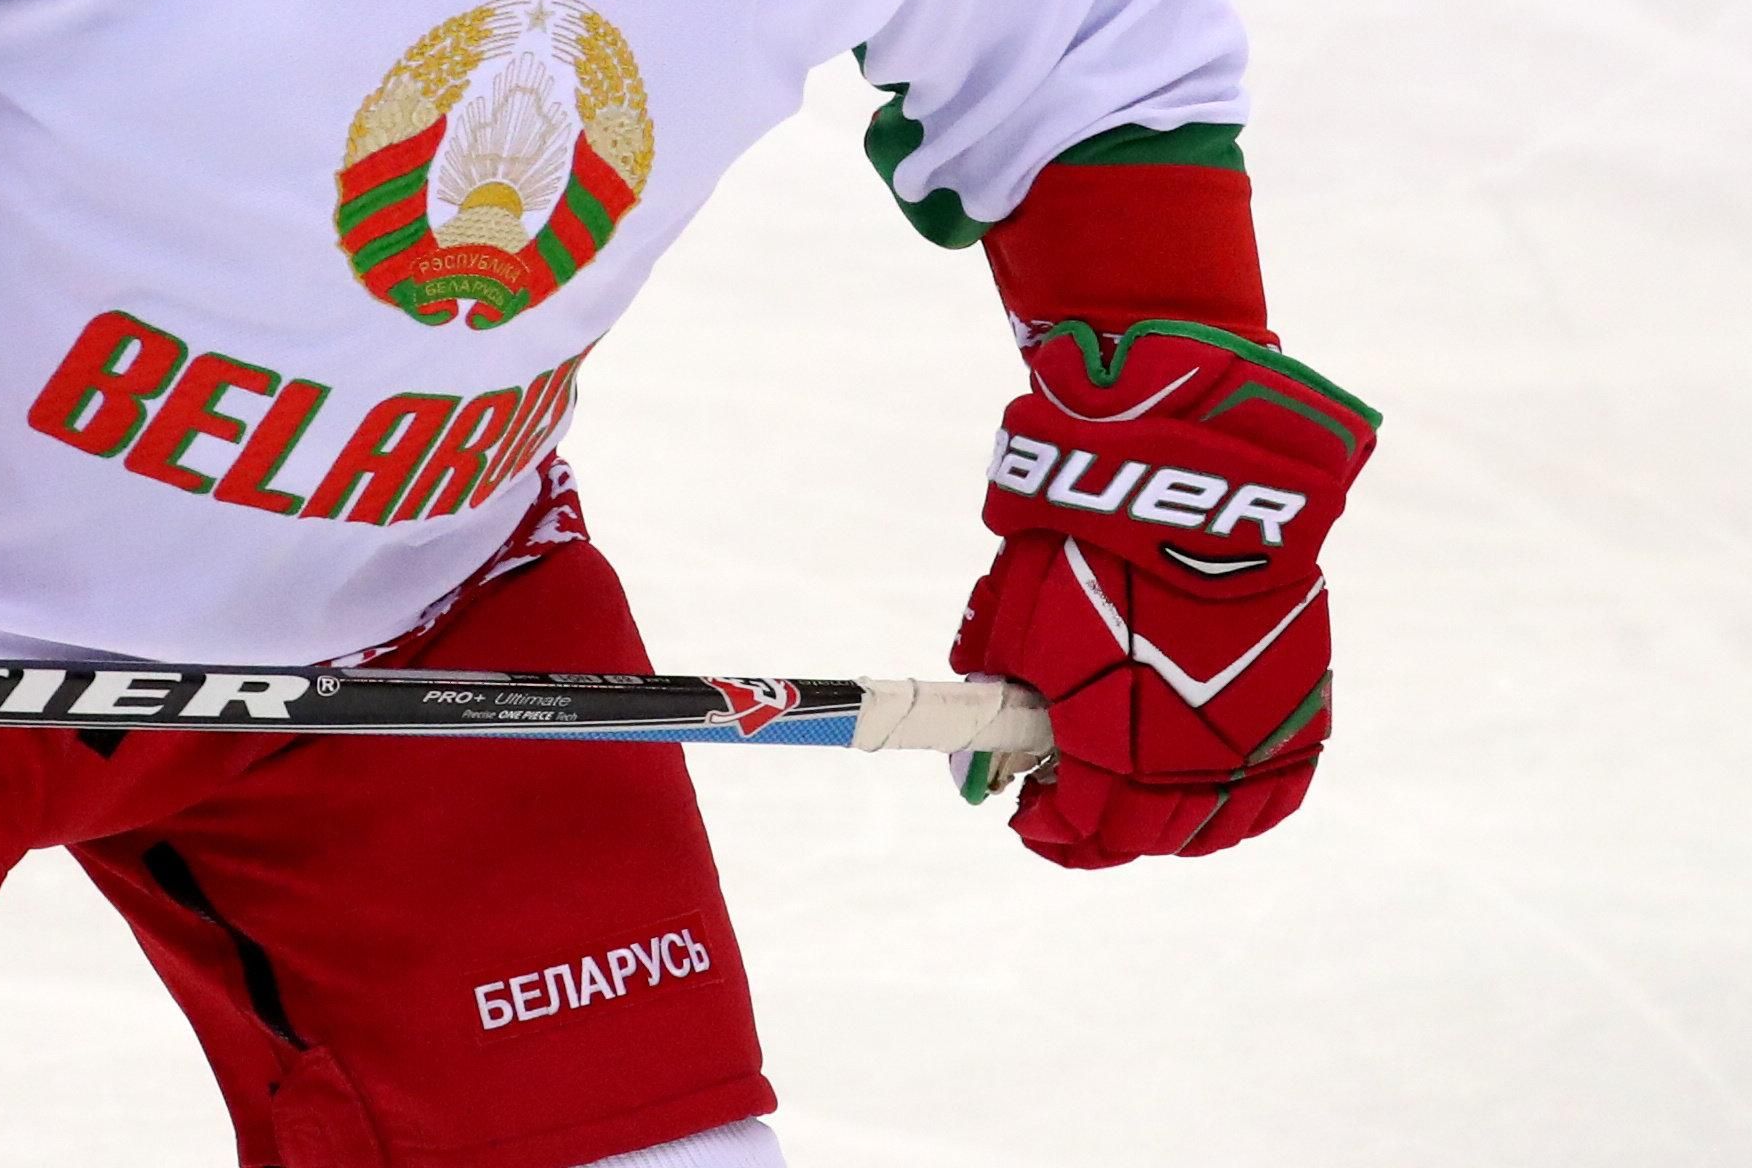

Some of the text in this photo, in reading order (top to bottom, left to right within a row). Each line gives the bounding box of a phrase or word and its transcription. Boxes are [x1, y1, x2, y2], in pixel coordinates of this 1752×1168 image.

[422, 690, 572, 707] PRO+ Ultimate
[498, 710, 522, 720] ONE
[522, 710, 554, 721] PIECE
[474, 929, 711, 1031] БЕЛАРУСЬ
